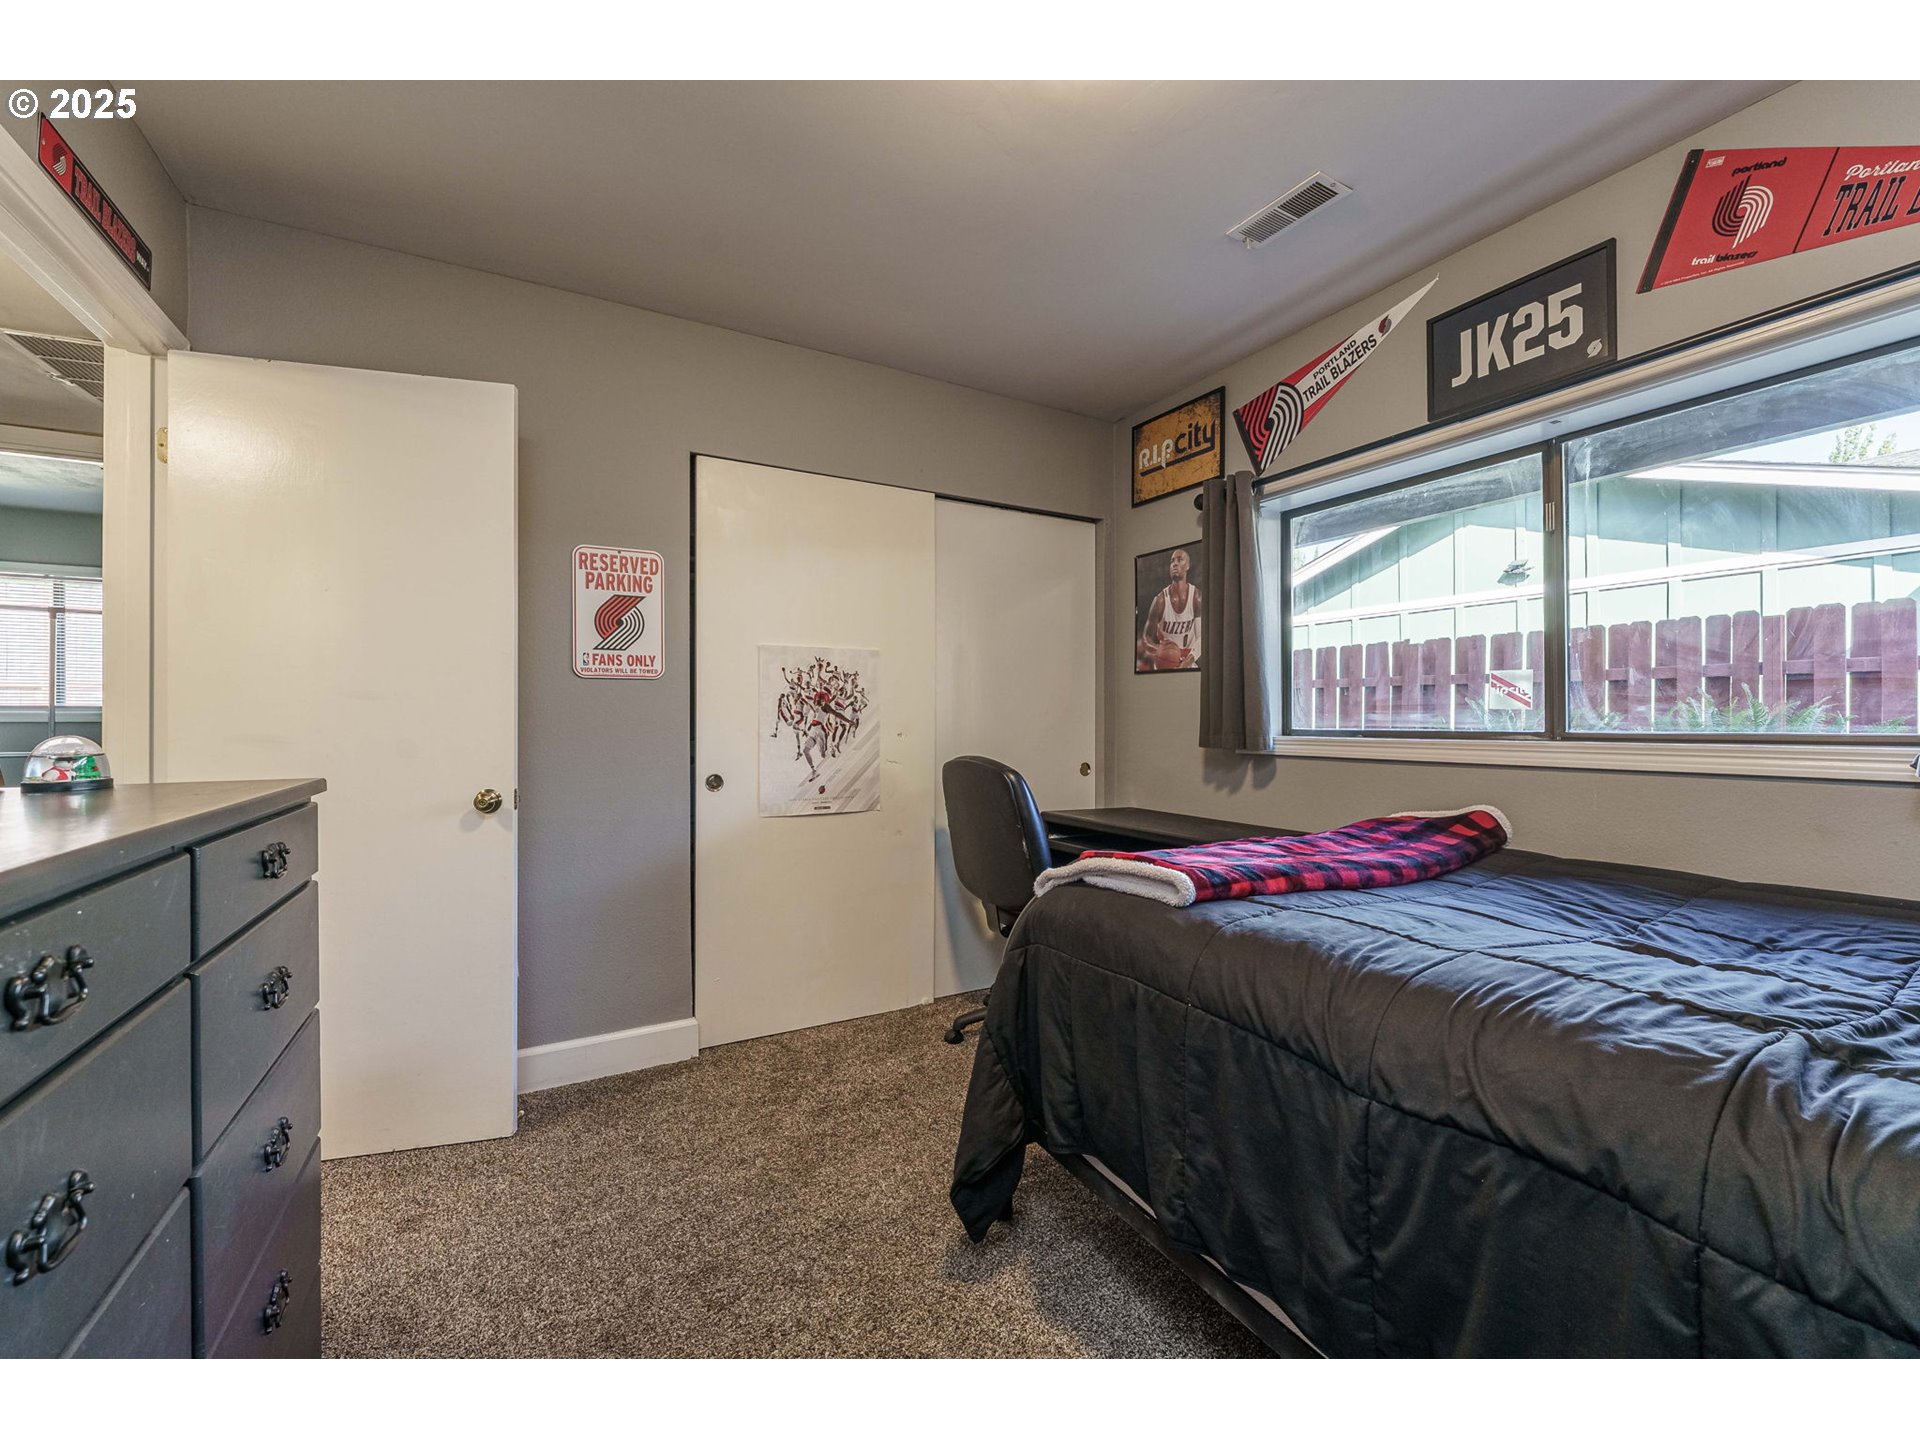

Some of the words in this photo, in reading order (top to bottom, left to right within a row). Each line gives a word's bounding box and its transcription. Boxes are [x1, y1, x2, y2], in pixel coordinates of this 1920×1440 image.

[1732, 156, 1788, 177] portland
[1821, 175, 1907, 237] TRAIL
[1691, 254, 1716, 266] trail
[1451, 282, 1584, 388] JK25
[1302, 375, 1331, 402] TRAIL
[1330, 334, 1377, 380] BLAZERS
[1313, 340, 1357, 380] PORTLAND
[578, 552, 660, 576] RESERVED
[585, 571, 654, 594] PARKING
[592, 653, 623, 666] FANS
[626, 654, 656, 667] ONLY
